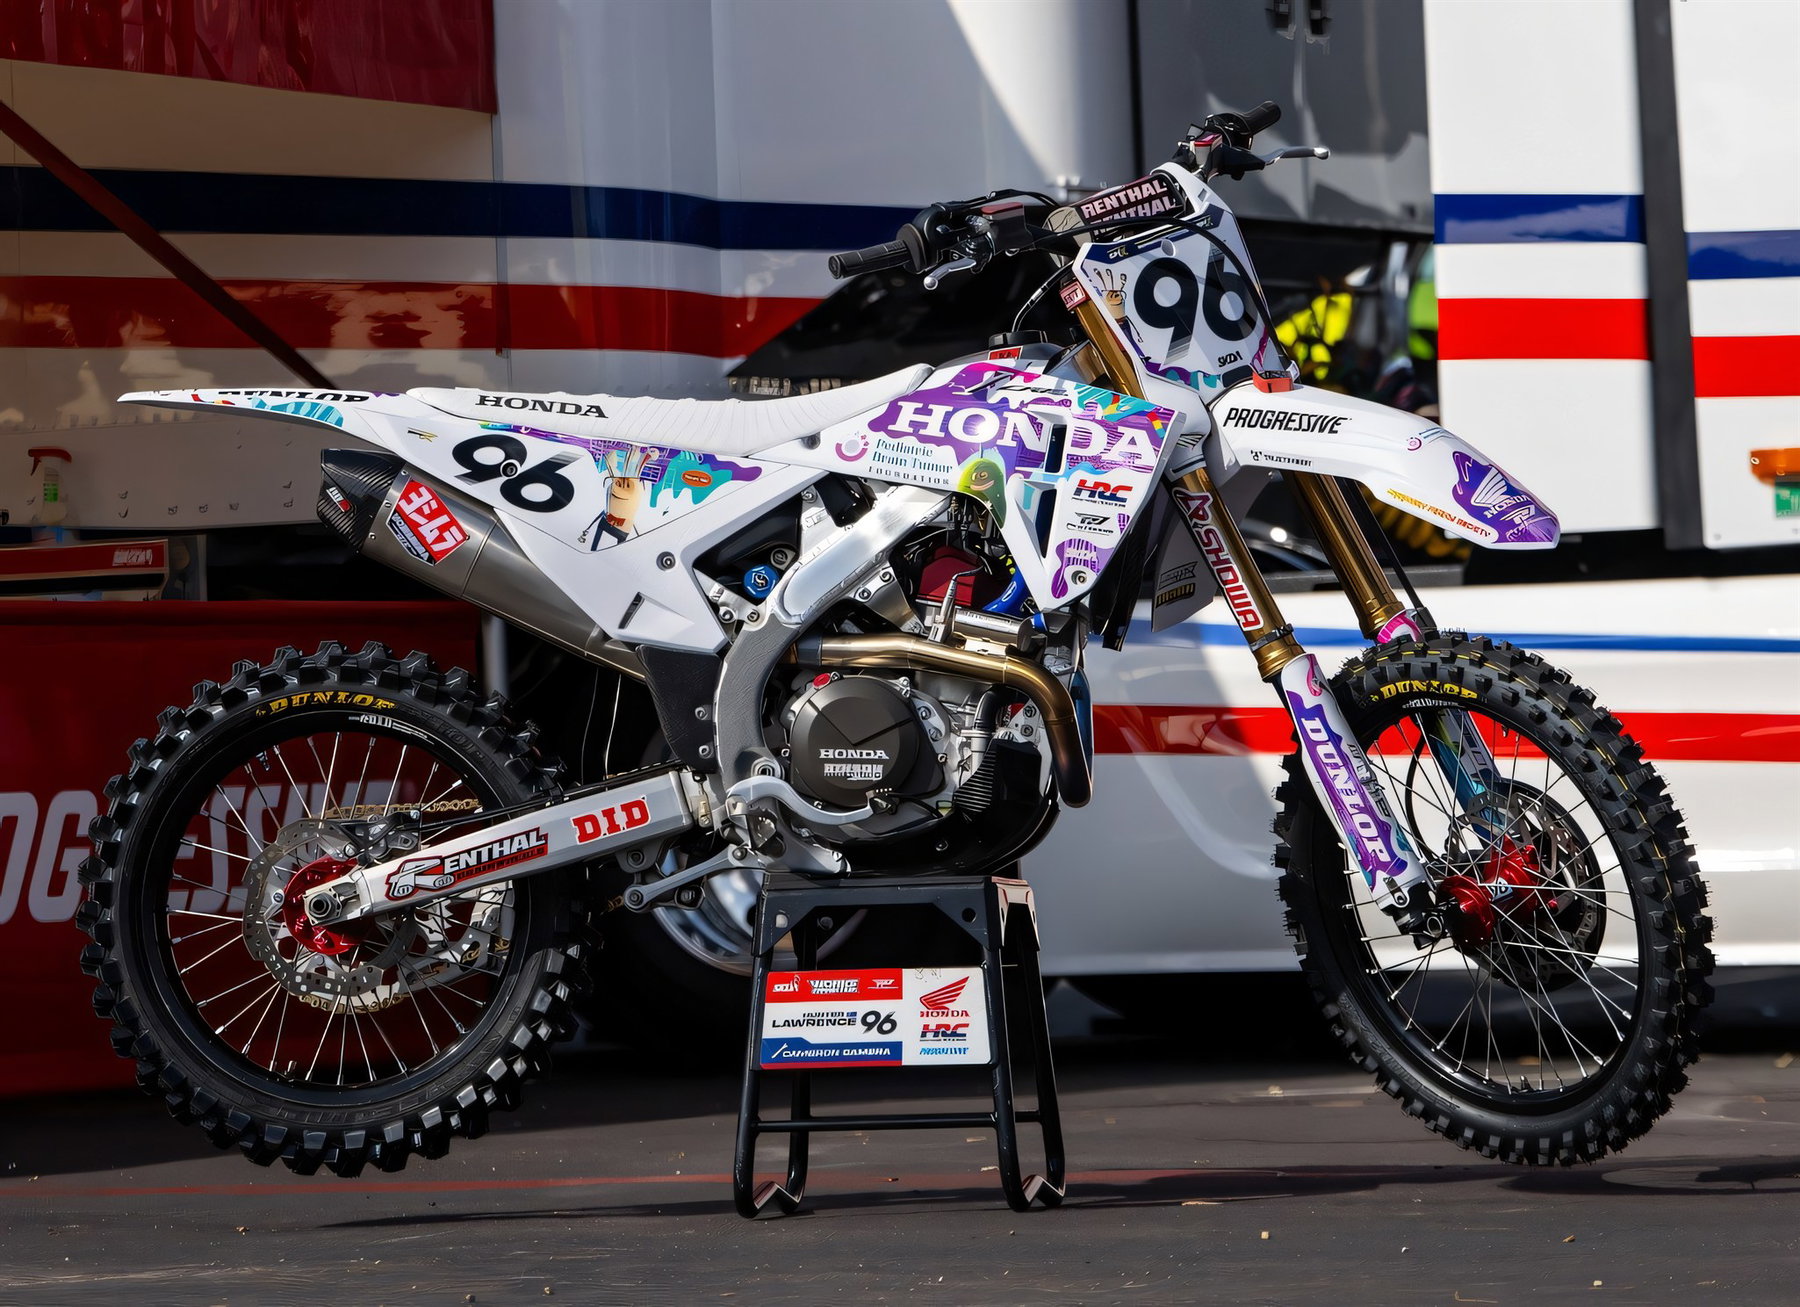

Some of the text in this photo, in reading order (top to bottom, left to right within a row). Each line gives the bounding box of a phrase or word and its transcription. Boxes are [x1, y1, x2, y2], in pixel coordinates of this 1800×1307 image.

[1081, 180, 1167, 219] RENTHAL
[1134, 240, 1259, 370] 96
[475, 394, 609, 418] HONDA
[888, 400, 1157, 467] HONDA
[1223, 407, 1349, 434] PROGRESSIVE
[452, 434, 584, 513] 96
[1073, 479, 1133, 503] HRC
[398, 486, 464, 552] ヨシムラ
[1380, 680, 1478, 700] DUNLOP
[819, 748, 889, 760] HONDA
[1301, 716, 1392, 863] DUNLOP
[861, 1010, 898, 1035] 96
[920, 1010, 970, 1018] HONDA
[920, 1023, 970, 1038] HRC
